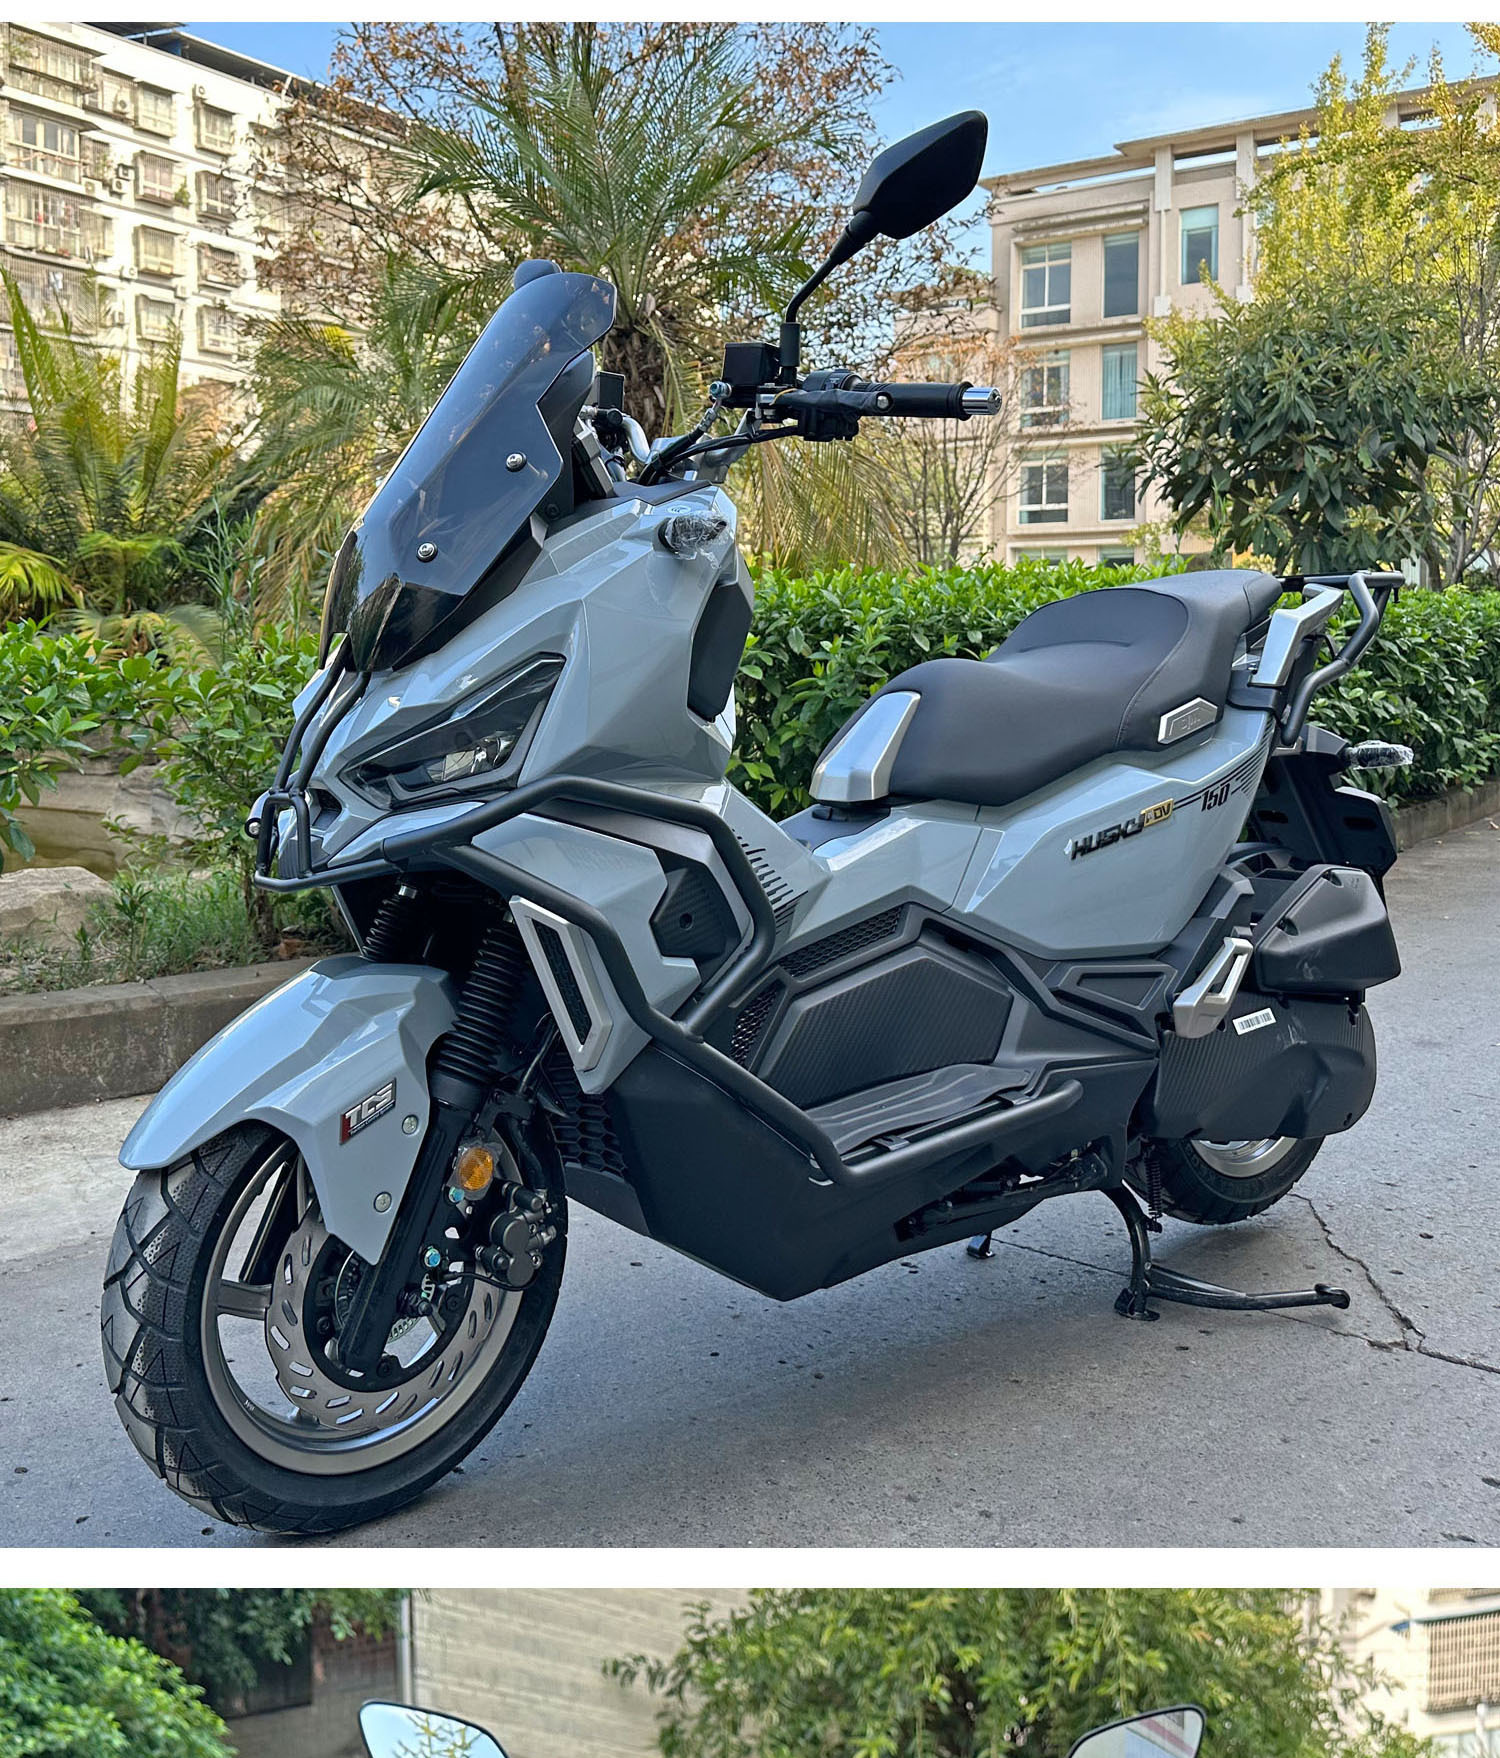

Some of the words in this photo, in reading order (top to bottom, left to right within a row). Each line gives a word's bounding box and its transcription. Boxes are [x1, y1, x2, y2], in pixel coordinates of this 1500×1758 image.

[1201, 783, 1230, 811] 150
[1071, 813, 1145, 861] HUSKY
[345, 1082, 393, 1128] TCS
